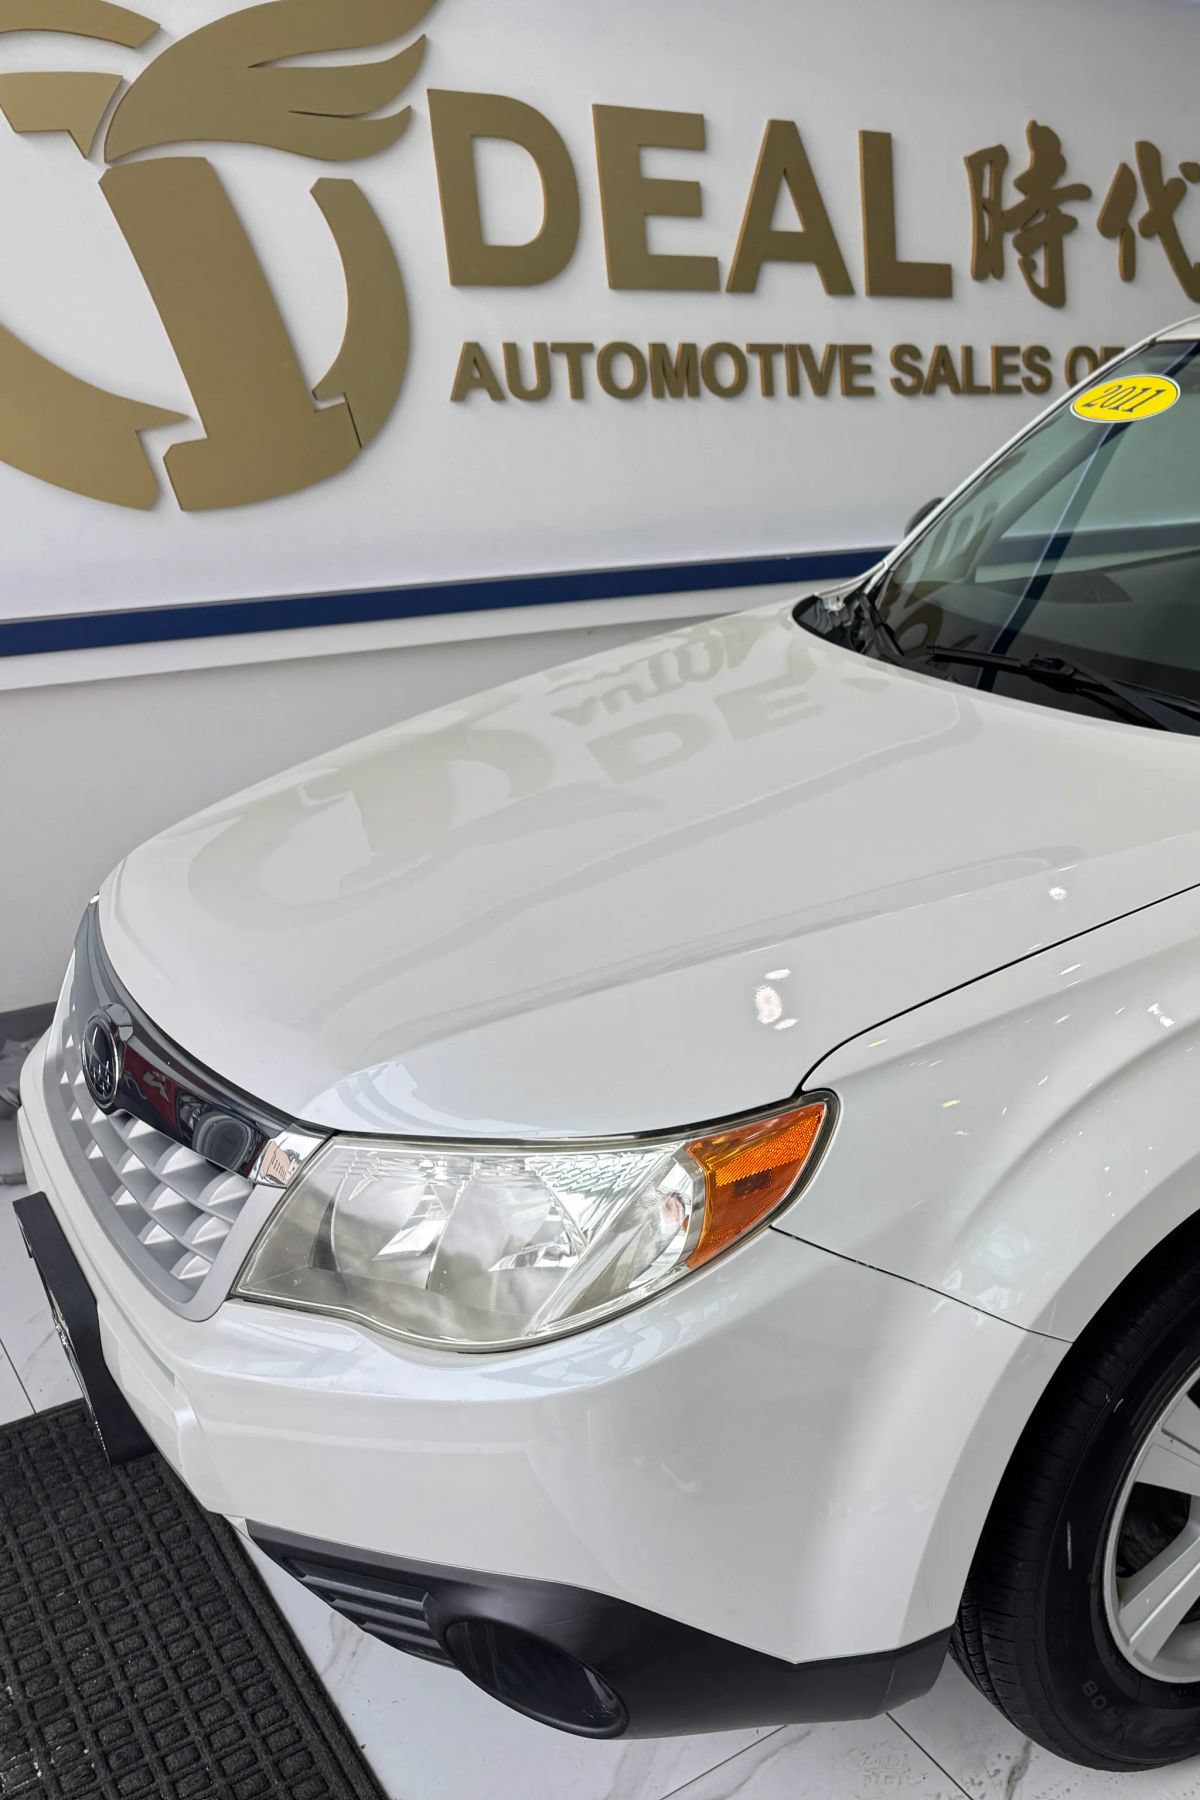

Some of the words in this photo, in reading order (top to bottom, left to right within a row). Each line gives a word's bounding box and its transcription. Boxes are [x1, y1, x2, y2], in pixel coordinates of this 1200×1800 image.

[427, 88, 953, 297] DEAL
[450, 341, 876, 402] AUTOMOTIVE
[890, 344, 1053, 396] SALES
[1064, 345, 1126, 389] O
[1082, 385, 1167, 412] 2011
